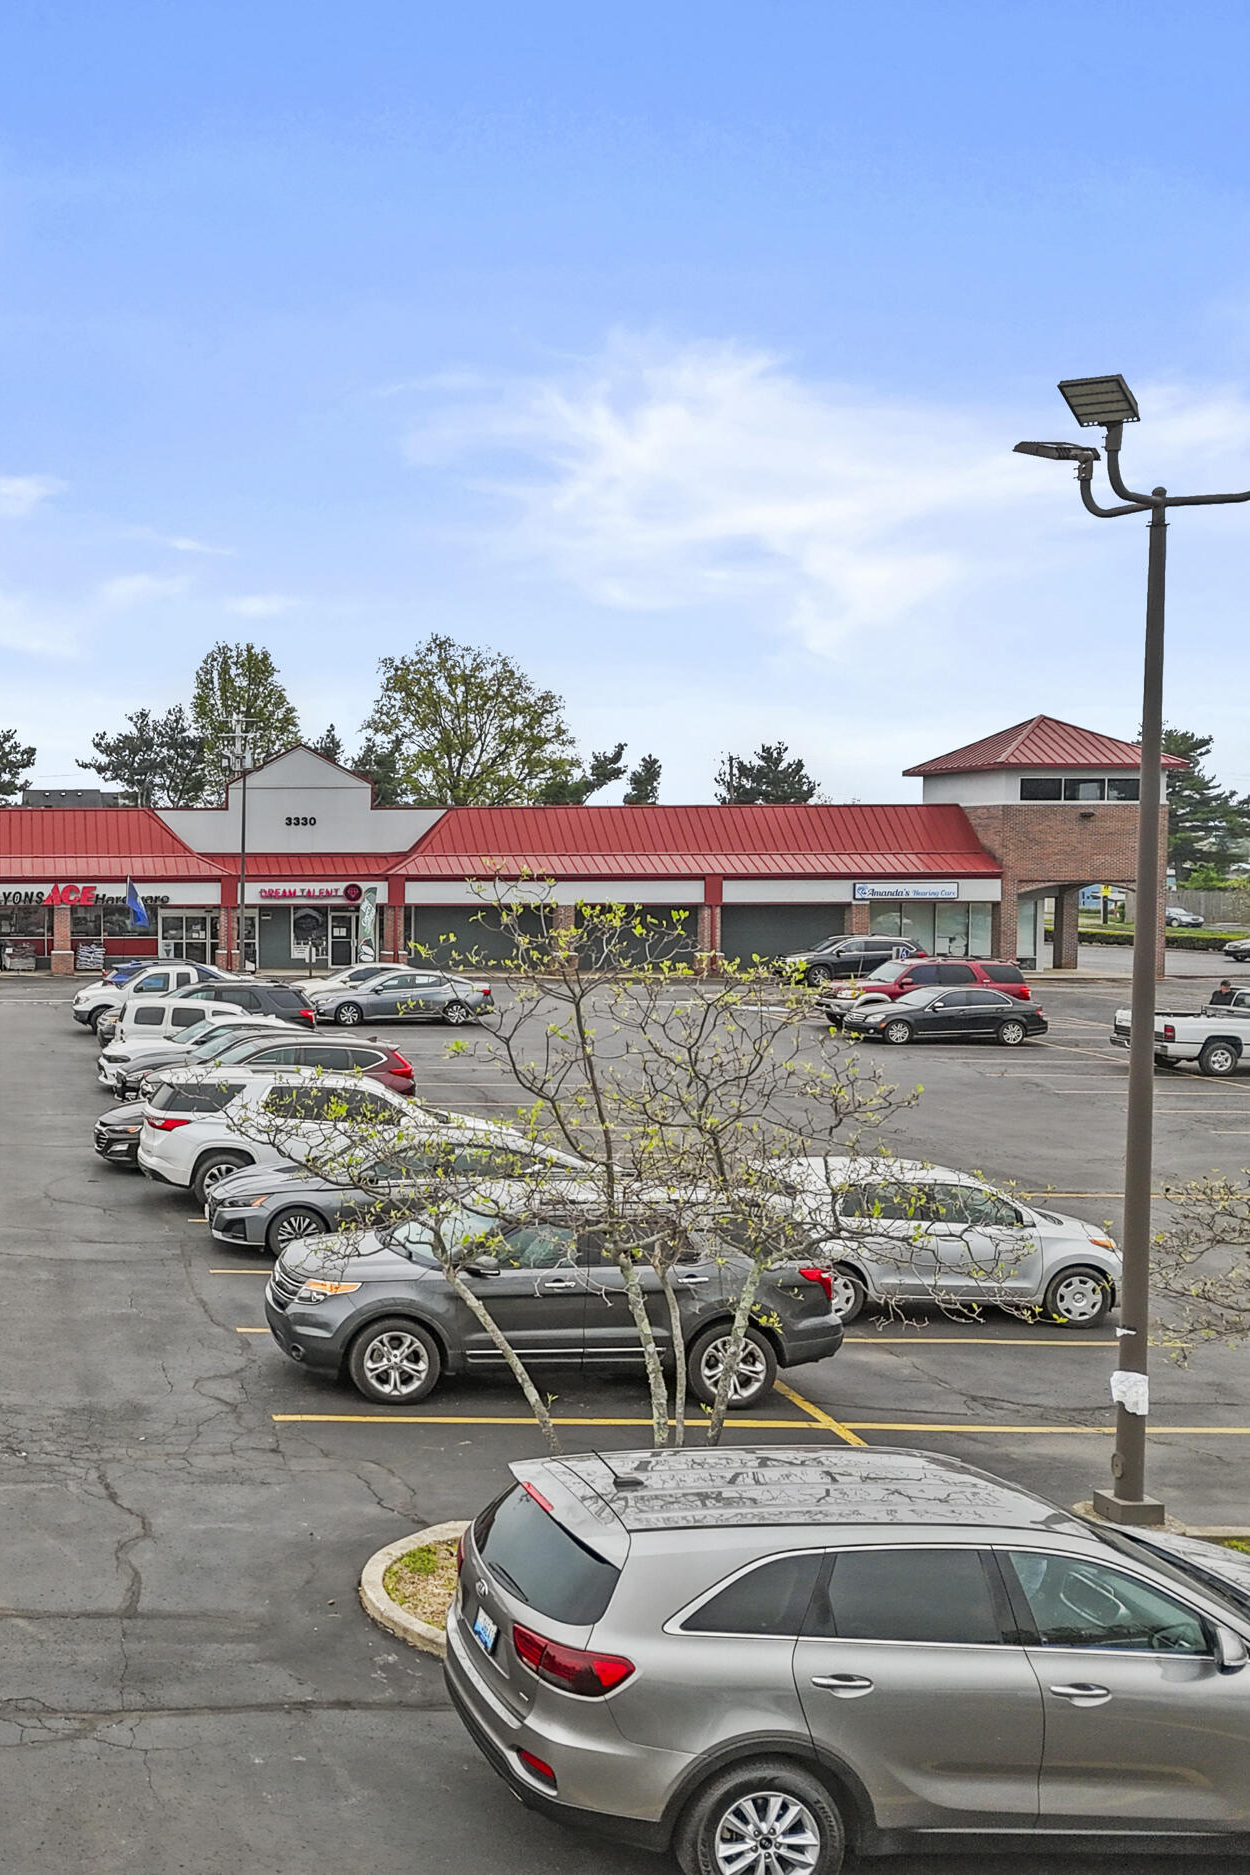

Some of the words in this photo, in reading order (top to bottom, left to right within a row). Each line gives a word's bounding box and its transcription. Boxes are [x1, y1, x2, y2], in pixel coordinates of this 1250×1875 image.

[285, 816, 317, 826] 3330
[43, 883, 97, 906] ACE
[260, 888, 296, 898] DREAM
[299, 888, 340, 898] TALENT
[867, 888, 910, 897] Amanda's
[912, 889, 940, 898] Hearing
[940, 889, 956, 897] Care
